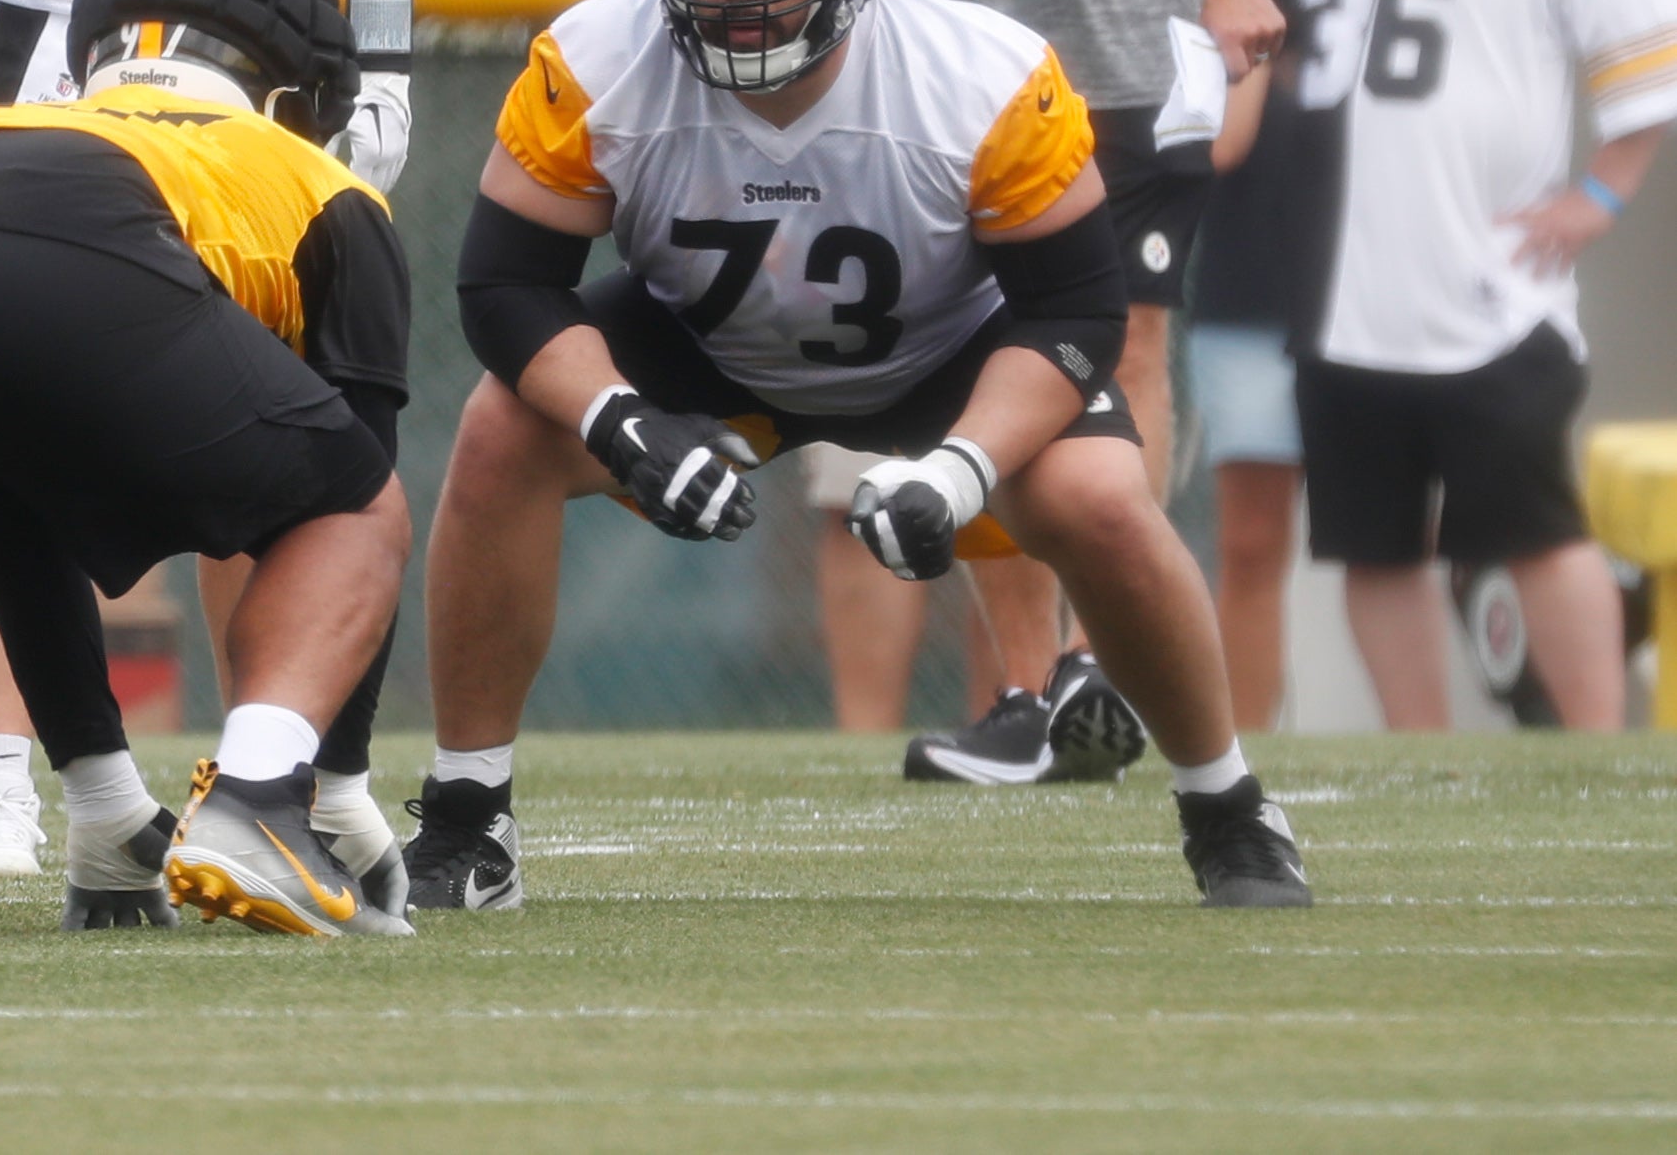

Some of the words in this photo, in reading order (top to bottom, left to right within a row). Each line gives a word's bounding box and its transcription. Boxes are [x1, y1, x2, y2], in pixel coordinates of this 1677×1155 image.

[119, 68, 178, 88] Steelers
[743, 180, 821, 204] Steelers
[669, 218, 904, 366] 73
